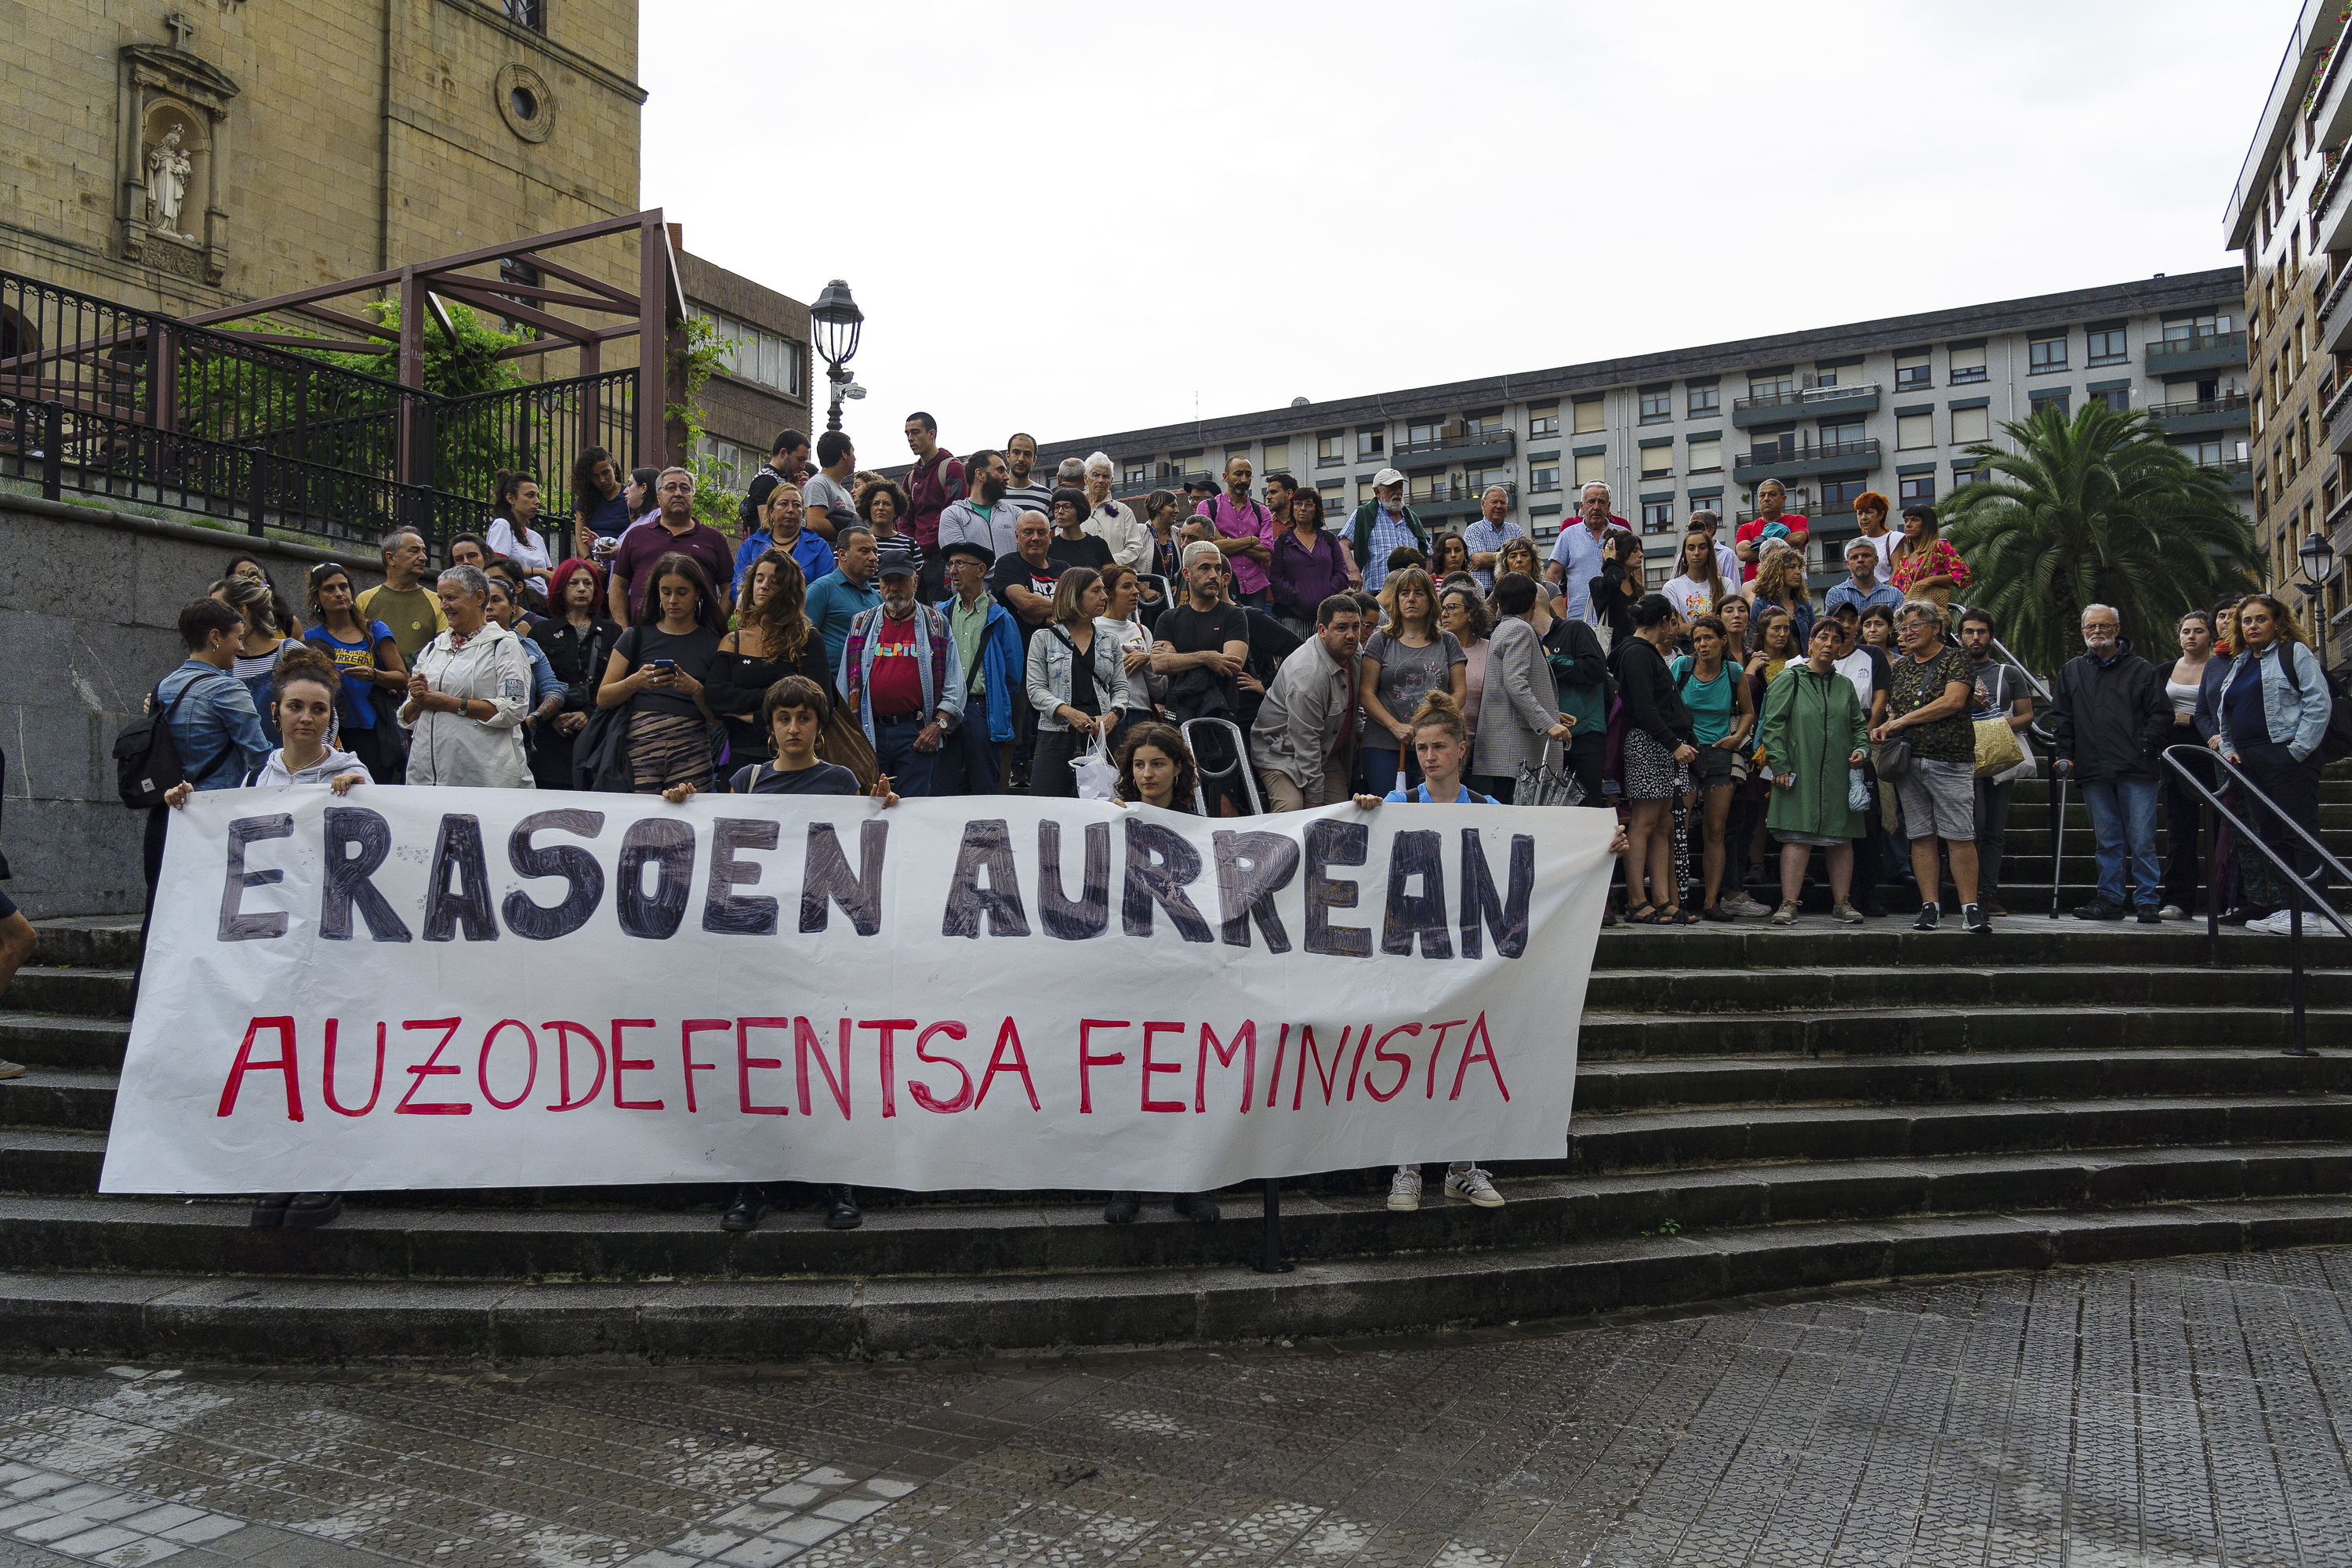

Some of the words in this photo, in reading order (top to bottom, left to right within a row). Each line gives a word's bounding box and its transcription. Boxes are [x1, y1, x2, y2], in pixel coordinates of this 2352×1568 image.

[217, 806, 889, 943] ERASOEN
[942, 817, 1535, 960] AURREAN
[216, 1015, 1041, 1123] AUZODEFENTSA
[1080, 1011, 1511, 1114] FEMINISTA
